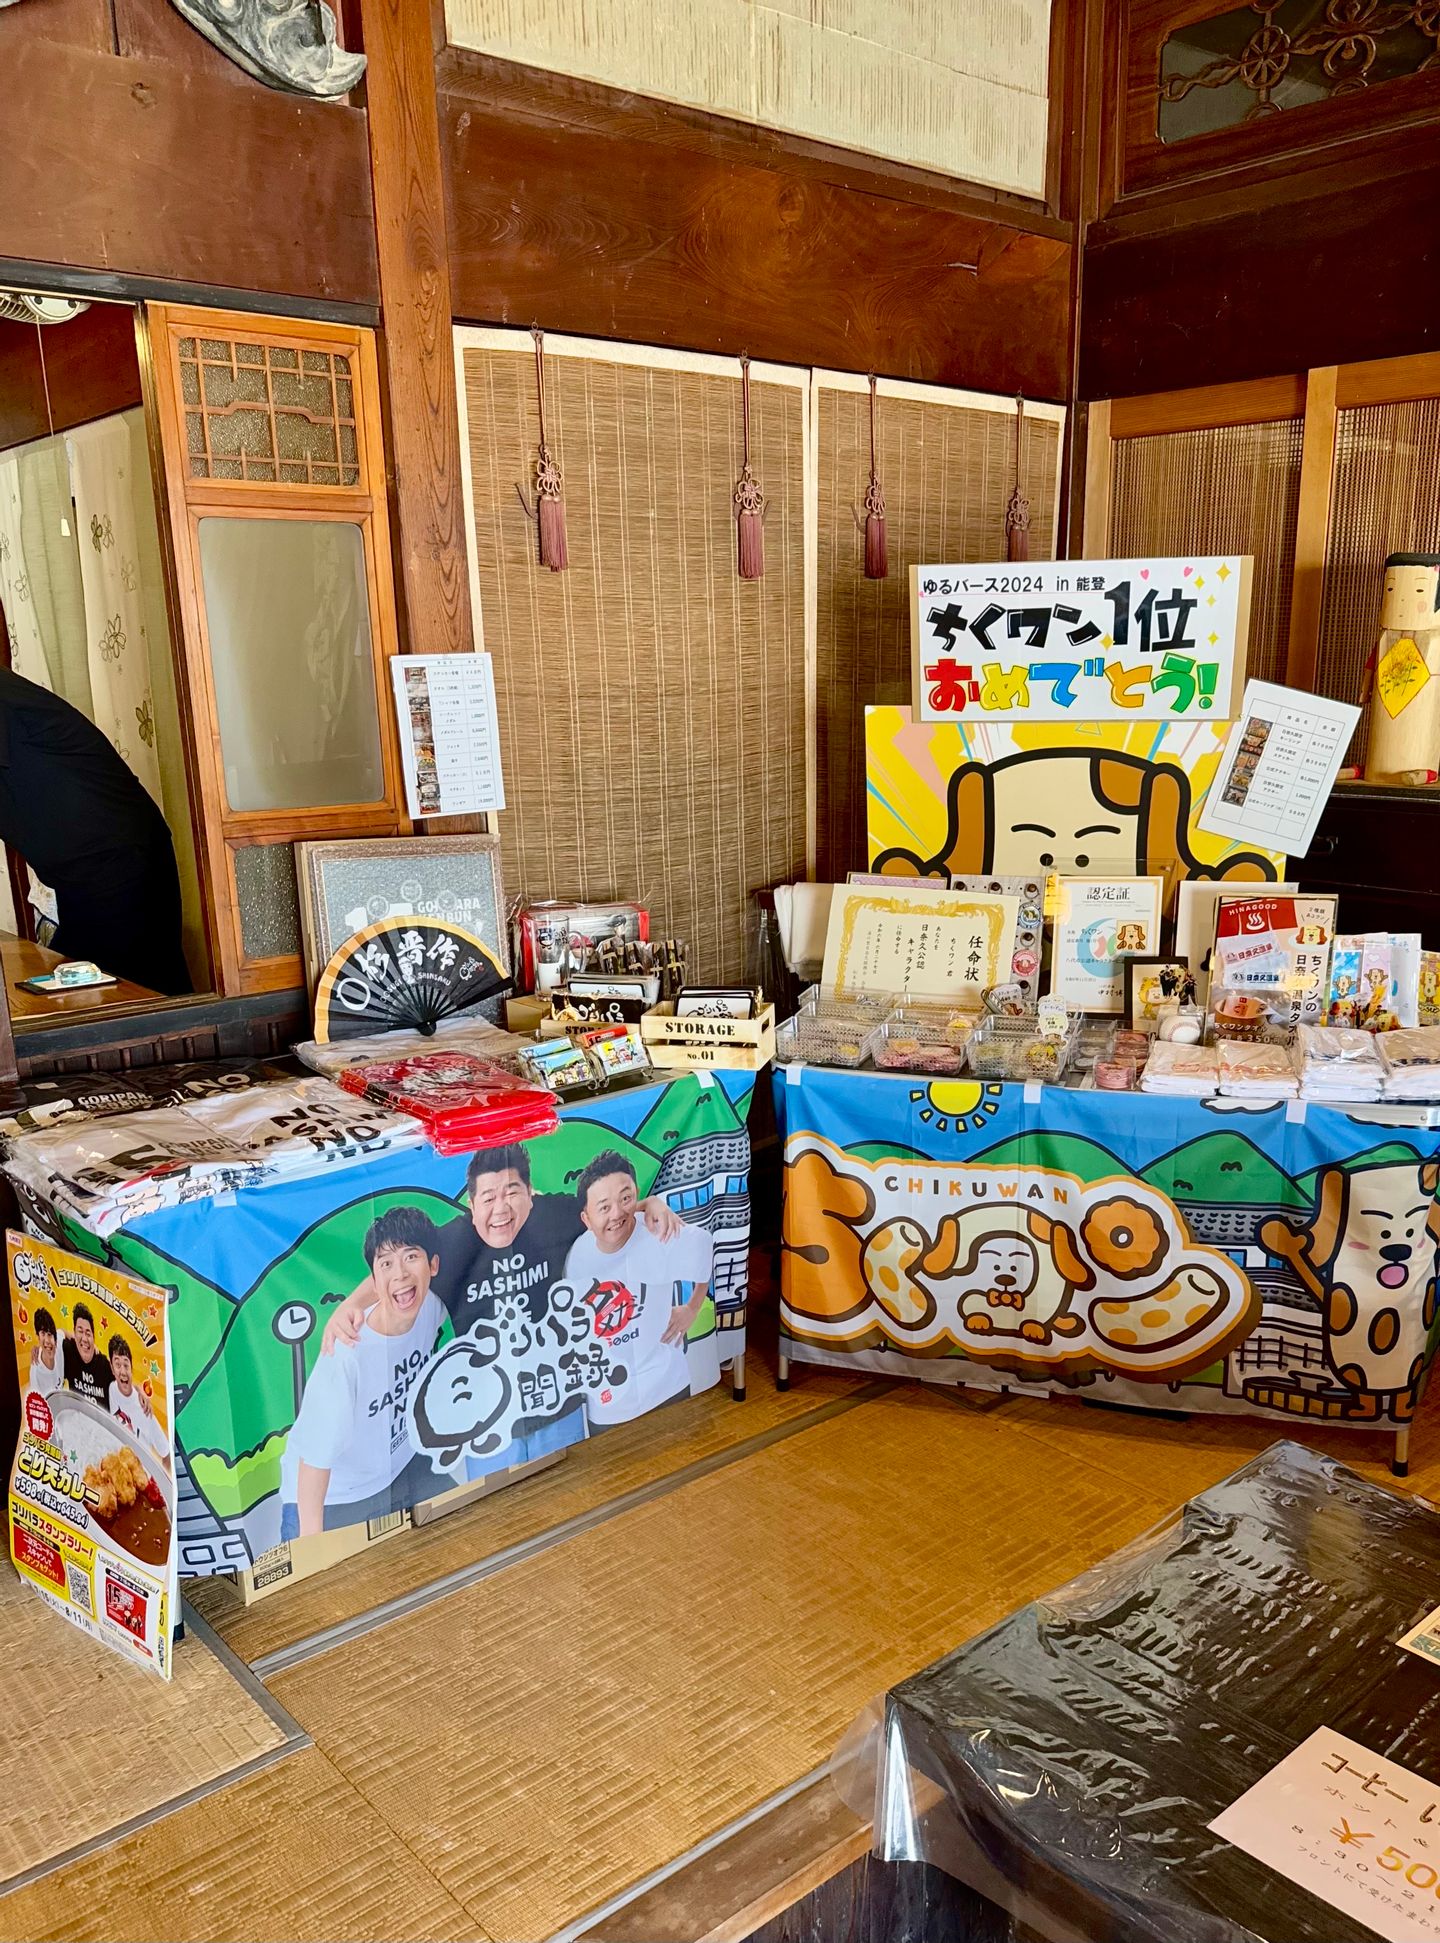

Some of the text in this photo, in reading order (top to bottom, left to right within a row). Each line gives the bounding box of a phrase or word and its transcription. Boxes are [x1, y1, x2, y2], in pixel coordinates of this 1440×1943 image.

[923, 575, 1106, 595] ゆるバース2024 in 能登
[1086, 886, 1131, 900] 認定証
[1228, 903, 1278, 916] HINAGOOD
[964, 935, 984, 982] 任命状
[665, 1021, 736, 1037] STORAGE
[687, 1050, 715, 1061] No.01
[884, 1175, 1069, 1205] CHIKUWAN
[492, 1253, 525, 1275] NO
[467, 1261, 549, 1303] SASHIMI
[394, 1349, 422, 1381] NO
[74, 1378, 105, 1398] SASHIMI
[81, 1371, 94, 1383] NO
[394, 1397, 408, 1419] N
[18, 1446, 100, 1505] とり天カレー
[257, 1566, 290, 1588] 28893
[1321, 1752, 1408, 1803] コーヒー
[1329, 1816, 1440, 1900] ¥50
